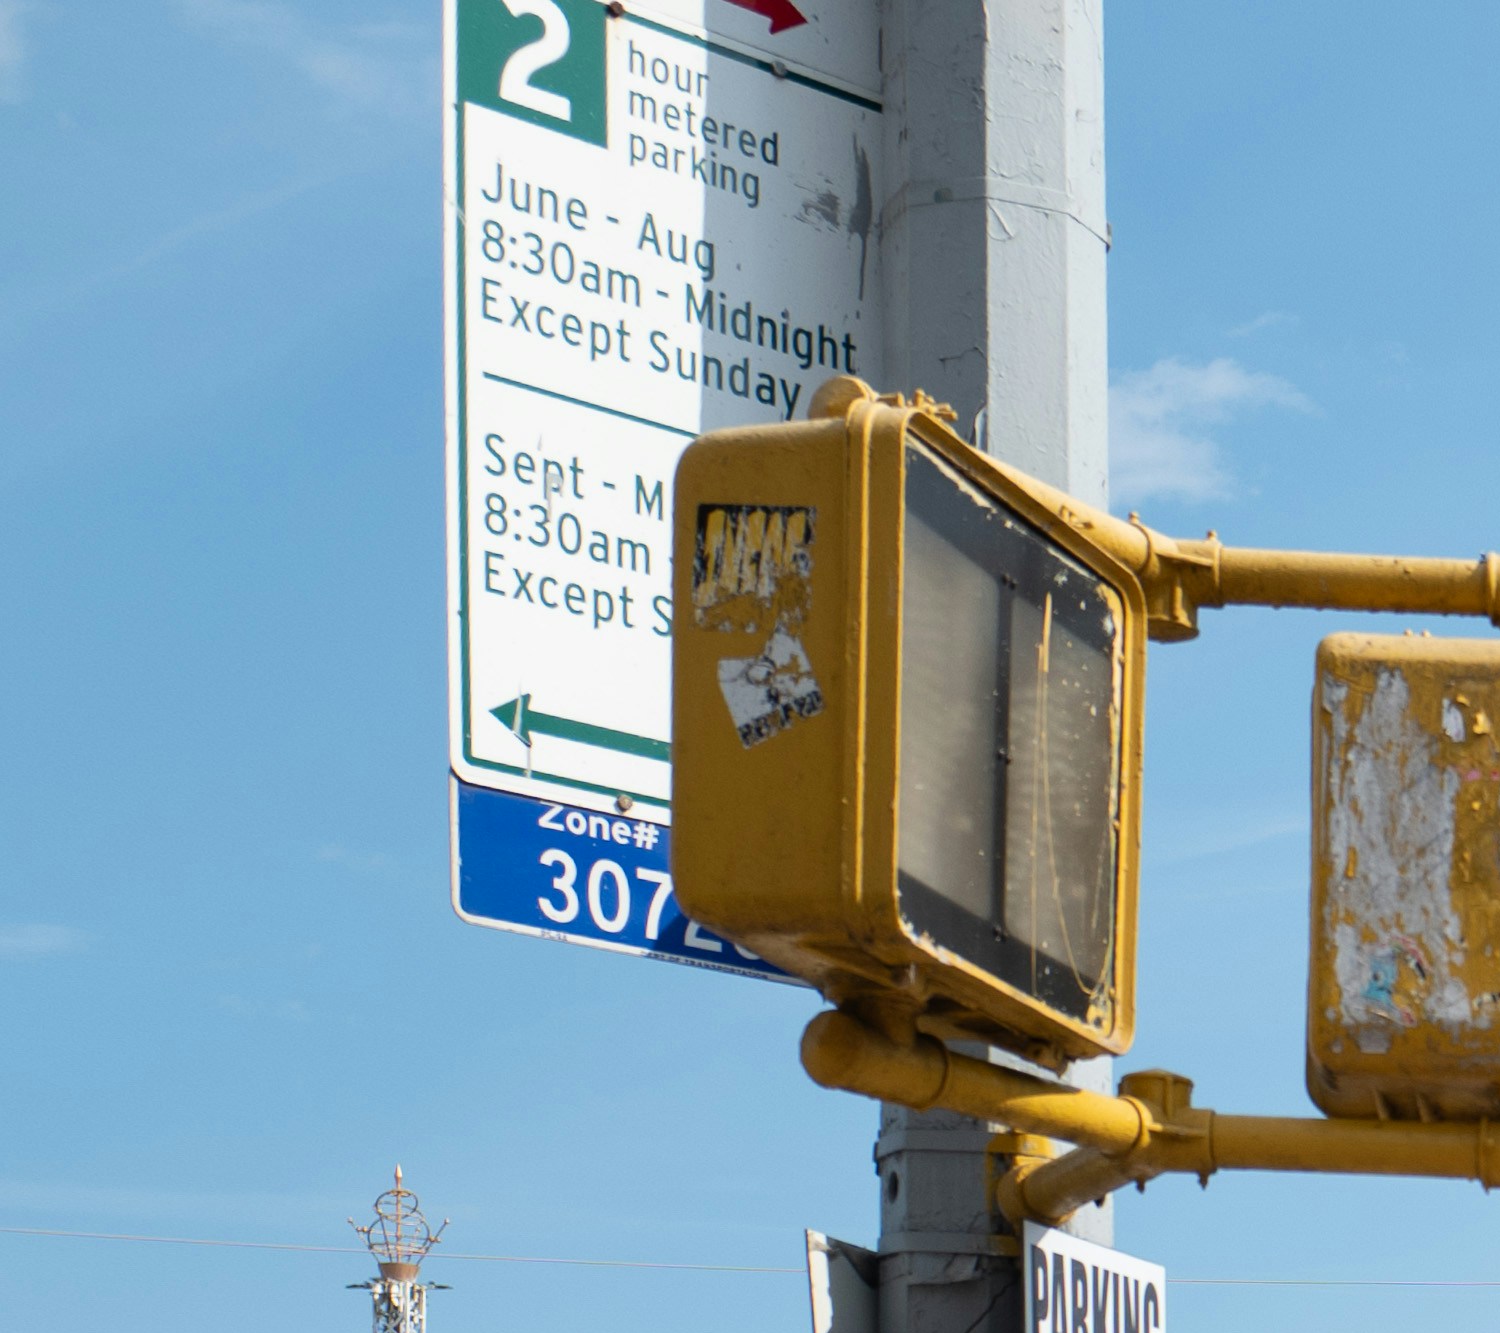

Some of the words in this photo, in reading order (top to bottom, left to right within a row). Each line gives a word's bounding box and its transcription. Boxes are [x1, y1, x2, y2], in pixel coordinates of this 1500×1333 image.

[499, 0, 573, 122] 2
[627, 39, 709, 97] hour
[628, 88, 780, 168] metered
[628, 131, 761, 207] parking
[481, 163, 589, 231] June
[637, 212, 716, 282] Aug
[481, 220, 642, 309] 8:30am
[684, 282, 858, 375] Midnight
[481, 279, 632, 365] Except
[648, 341, 802, 422] Sunday
[483, 434, 586, 512] Sept
[483, 491, 652, 578] 8:30am
[483, 551, 635, 634] Except
[538, 800, 659, 850] Zone#
[538, 847, 762, 961] 307
